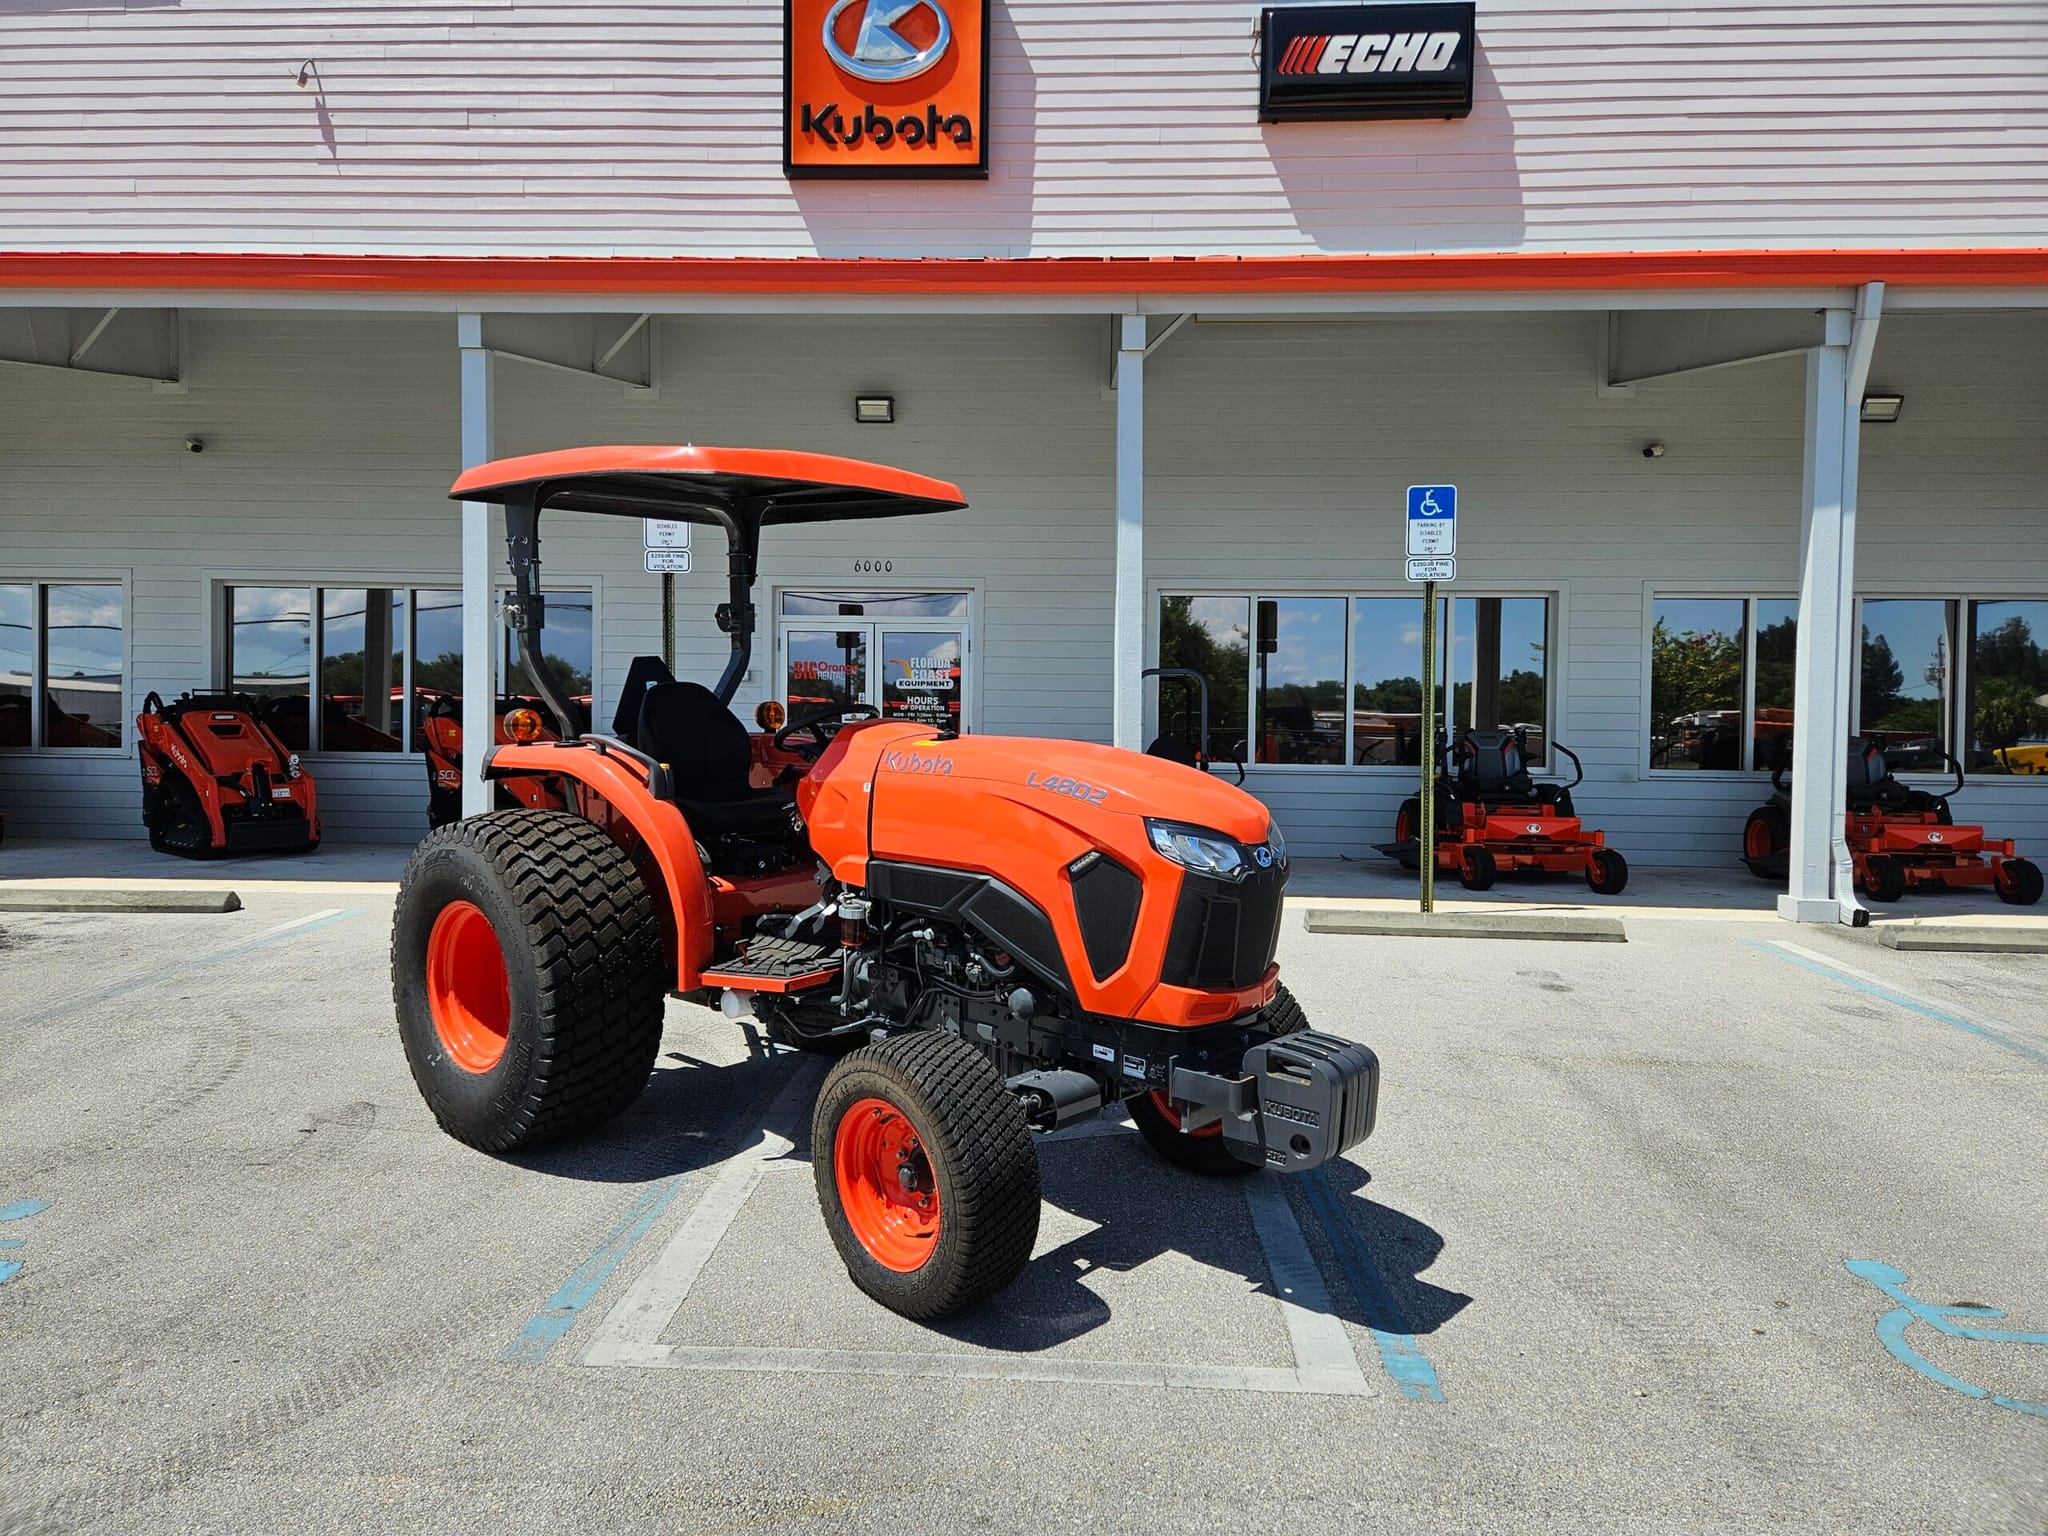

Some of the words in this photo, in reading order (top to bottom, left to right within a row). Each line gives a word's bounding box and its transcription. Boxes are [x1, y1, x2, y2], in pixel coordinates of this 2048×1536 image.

[1317, 31, 1461, 74] ECHO
[801, 103, 972, 145] Kubota
[855, 559, 893, 573] 6000
[793, 661, 817, 680] BIG
[818, 661, 859, 674] Orange
[910, 657, 951, 668] FLORIDA
[911, 669, 951, 680] COAST
[907, 696, 939, 705] HOURS
[884, 751, 953, 774] Kubota
[439, 770, 456, 780] SCL
[1025, 771, 1108, 806] L4802
[1264, 1100, 1319, 1127] KUBOTA
